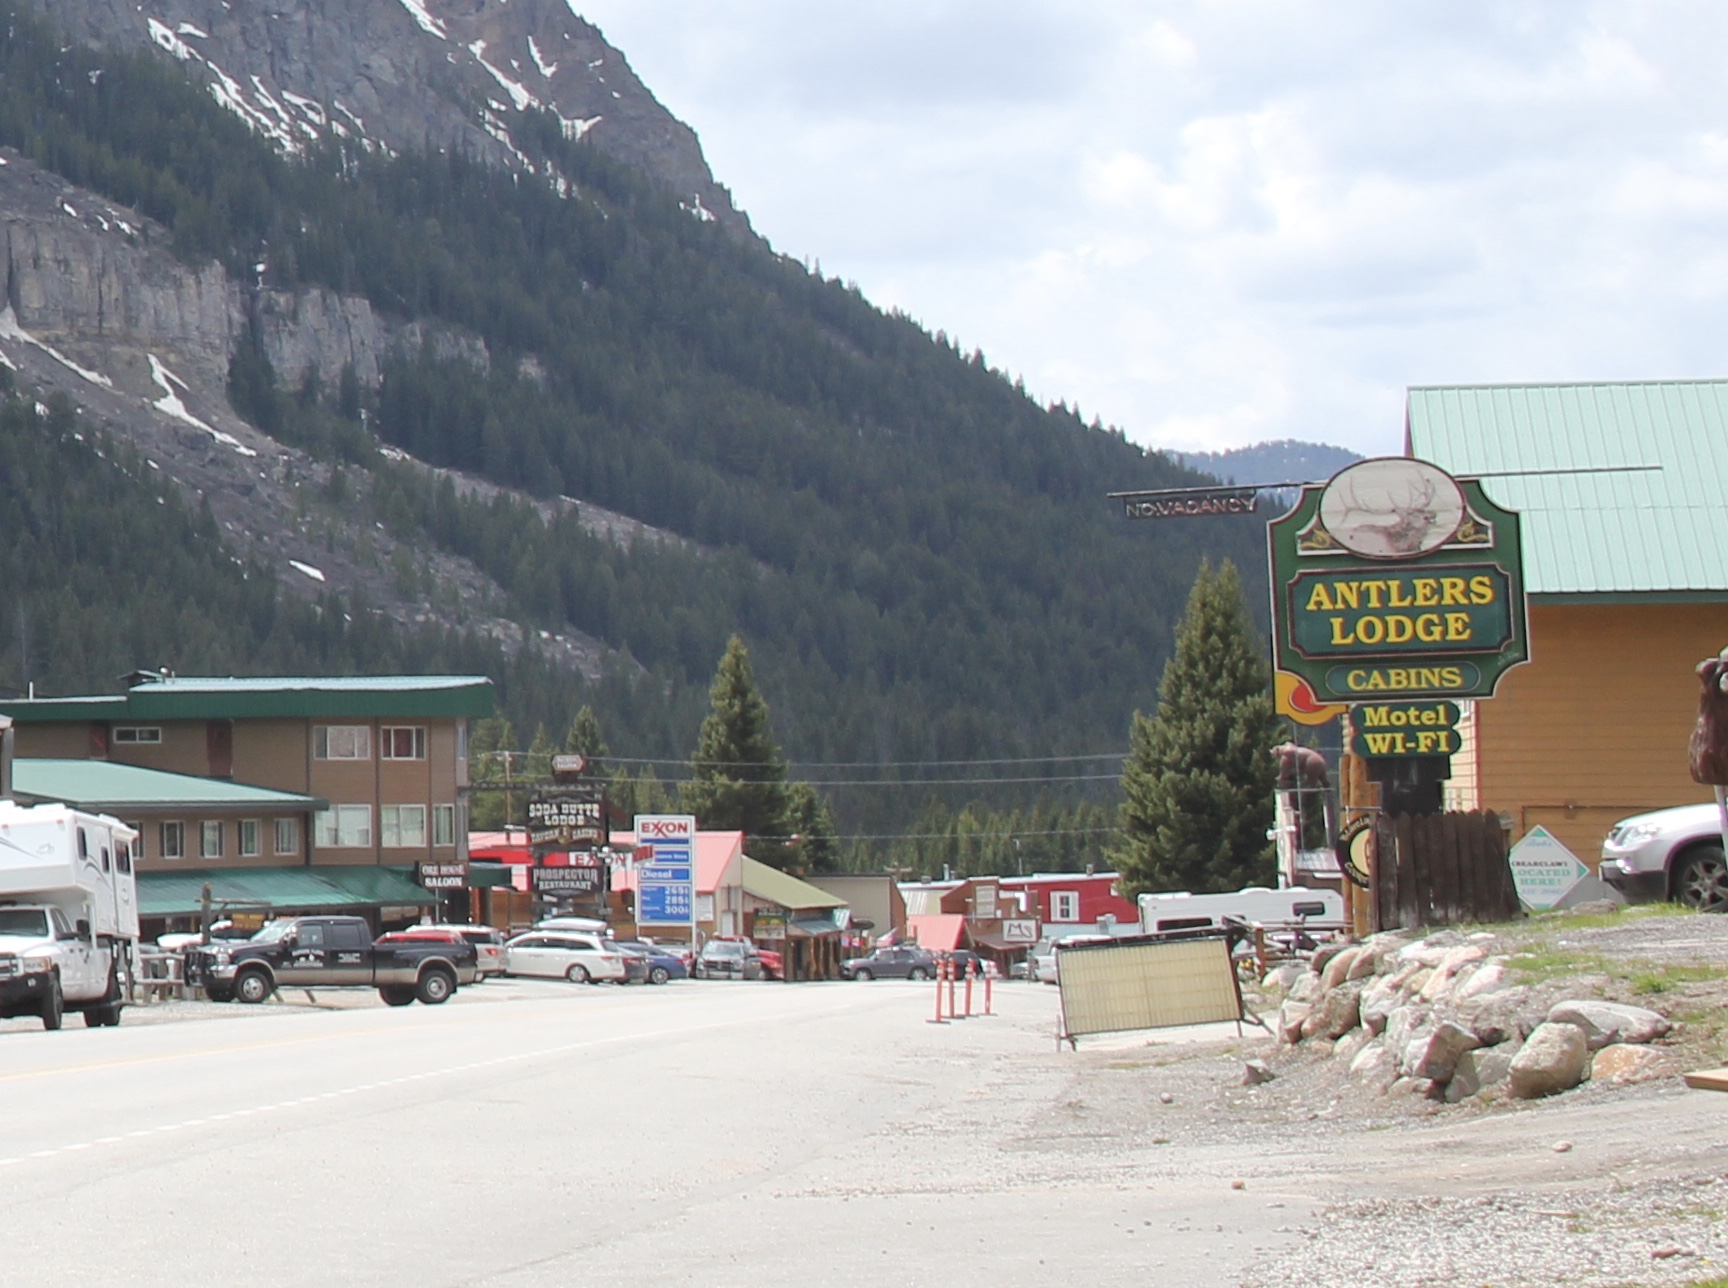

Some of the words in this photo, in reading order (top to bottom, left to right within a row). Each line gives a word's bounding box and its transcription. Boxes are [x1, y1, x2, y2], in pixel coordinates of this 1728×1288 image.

[1306, 575, 1495, 611] ANTLERS
[1329, 612, 1472, 645] LODGE
[1346, 666, 1464, 692] CABINS
[1362, 704, 1448, 727] Motel
[1363, 730, 1450, 755] WI-FI
[528, 803, 558, 818] SODA
[544, 814, 585, 826] LODGE
[641, 821, 688, 838] EXXON
[424, 877, 463, 887] SALOON
[533, 868, 599, 885] PROSPECTOR
[641, 870, 672, 879] Diesel
